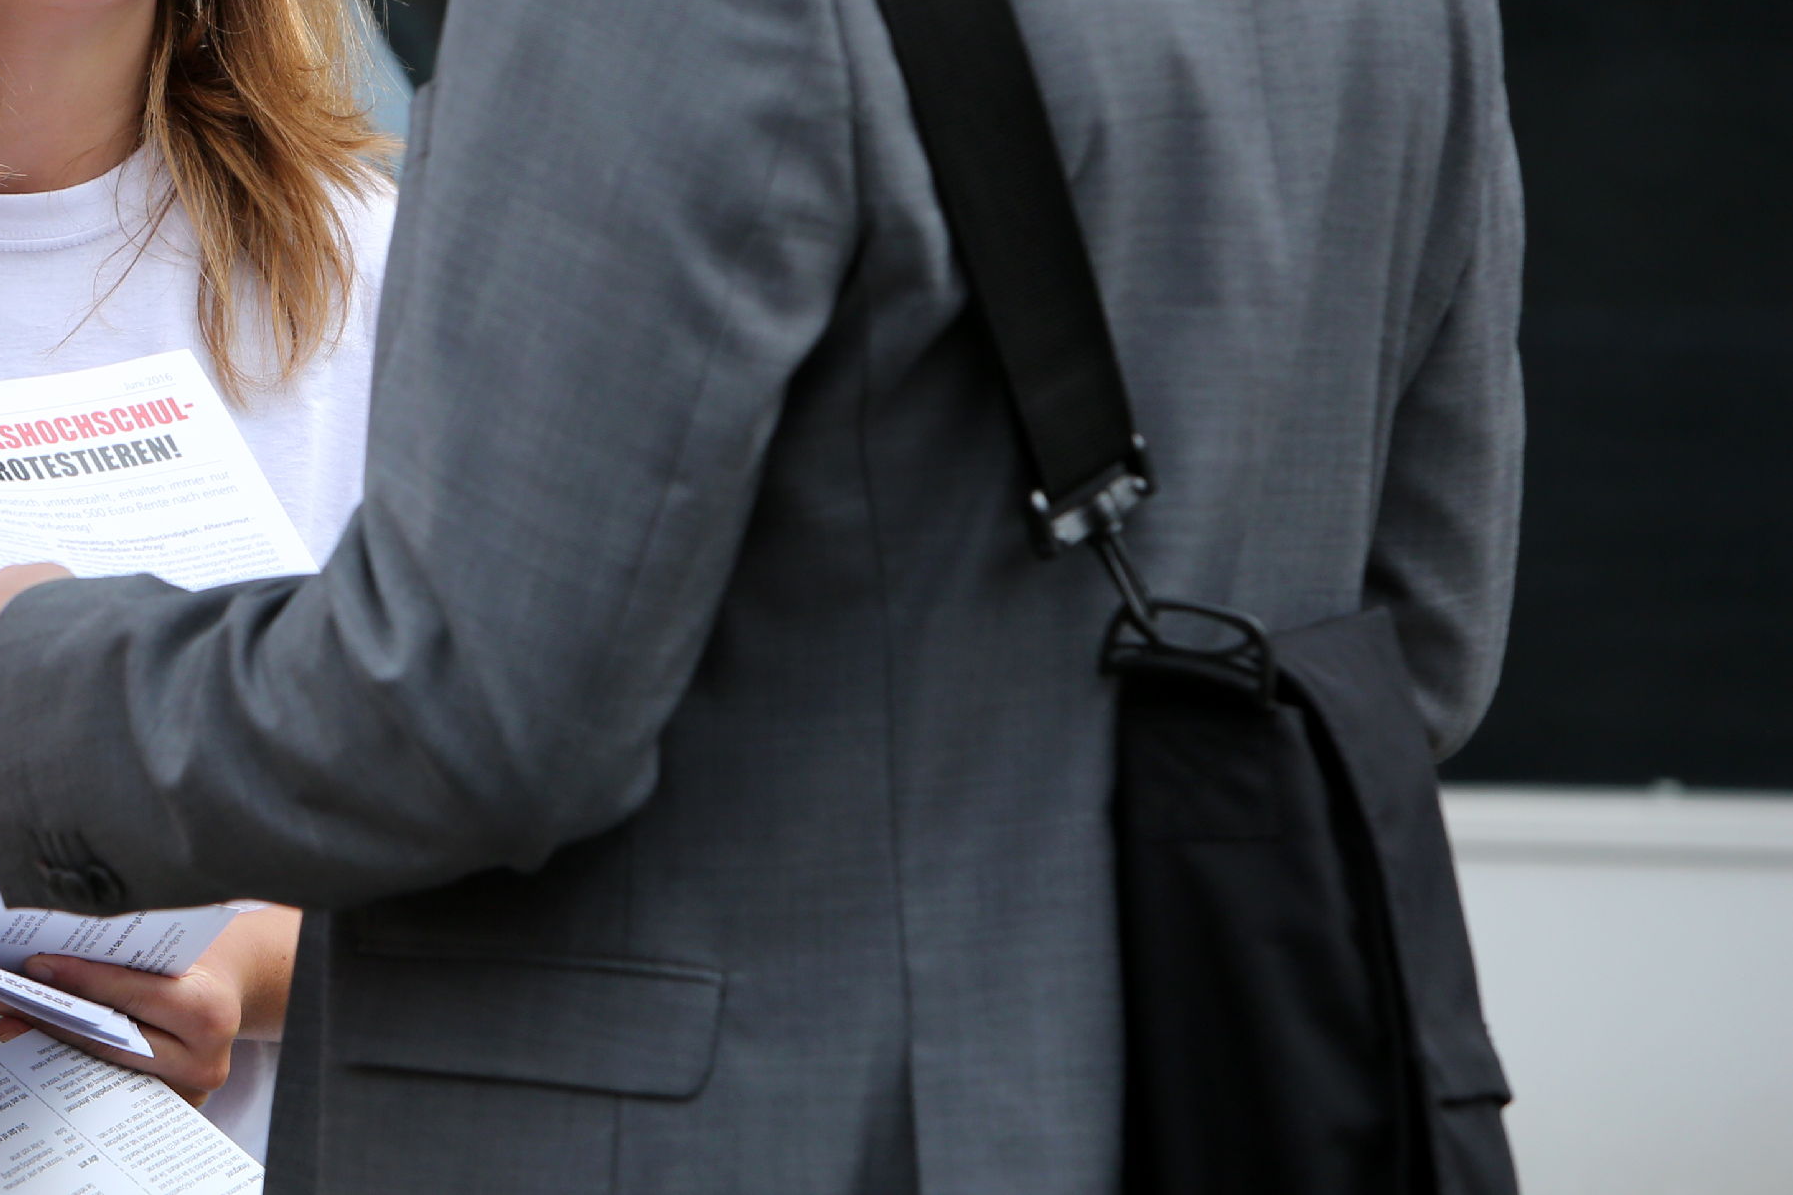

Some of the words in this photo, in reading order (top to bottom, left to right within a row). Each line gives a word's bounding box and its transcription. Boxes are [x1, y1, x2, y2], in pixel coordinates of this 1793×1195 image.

[146, 372, 174, 388] 2016
[118, 483, 165, 500] erhalten
[168, 475, 206, 491] immer
[208, 470, 230, 482] nur
[82, 507, 106, 519] 500
[108, 504, 135, 517] Euro
[136, 497, 171, 512] Rente
[172, 491, 201, 505] nach
[202, 484, 239, 499] einem
